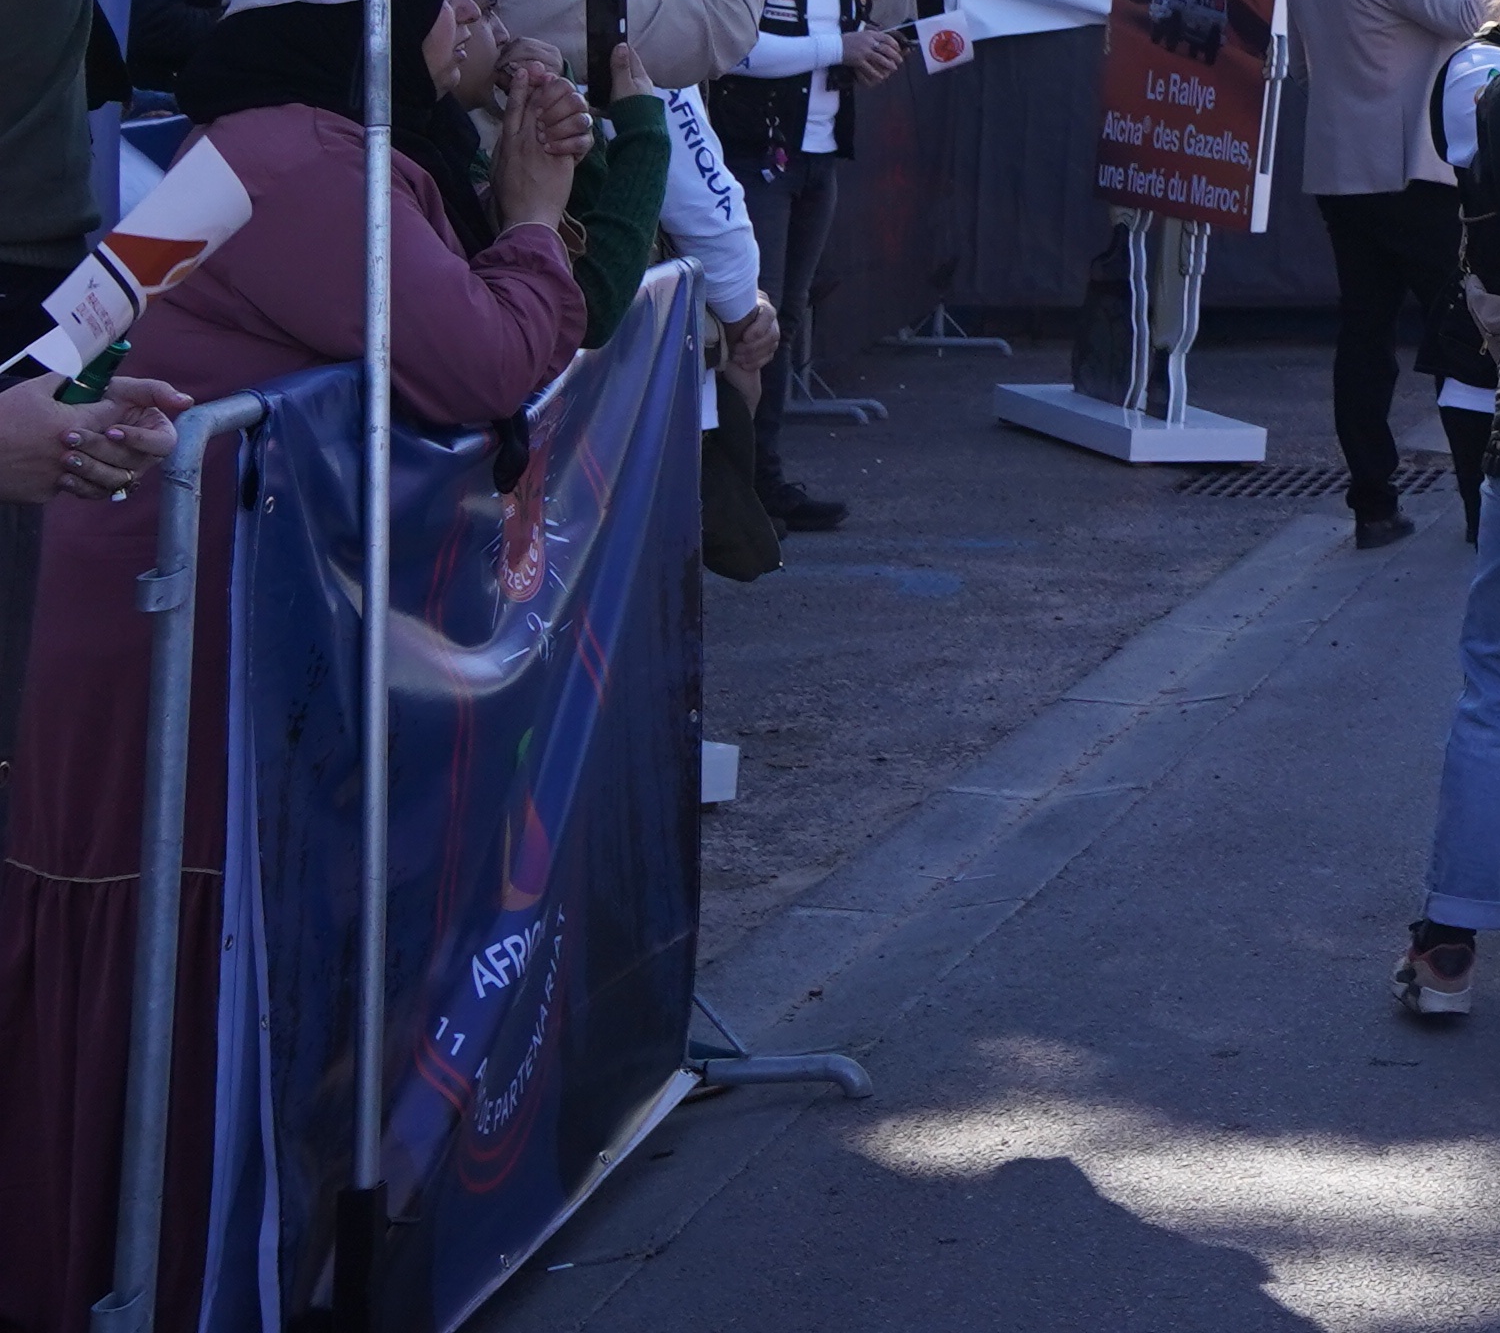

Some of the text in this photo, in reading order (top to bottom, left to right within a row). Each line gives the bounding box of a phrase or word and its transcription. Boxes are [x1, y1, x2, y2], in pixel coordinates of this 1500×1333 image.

[1146, 69, 1216, 114] Le Rallye
[1153, 120, 1180, 152] des
[1099, 163, 1124, 190] une
[1168, 171, 1188, 203] du
[1190, 174, 1240, 213] Maroc
